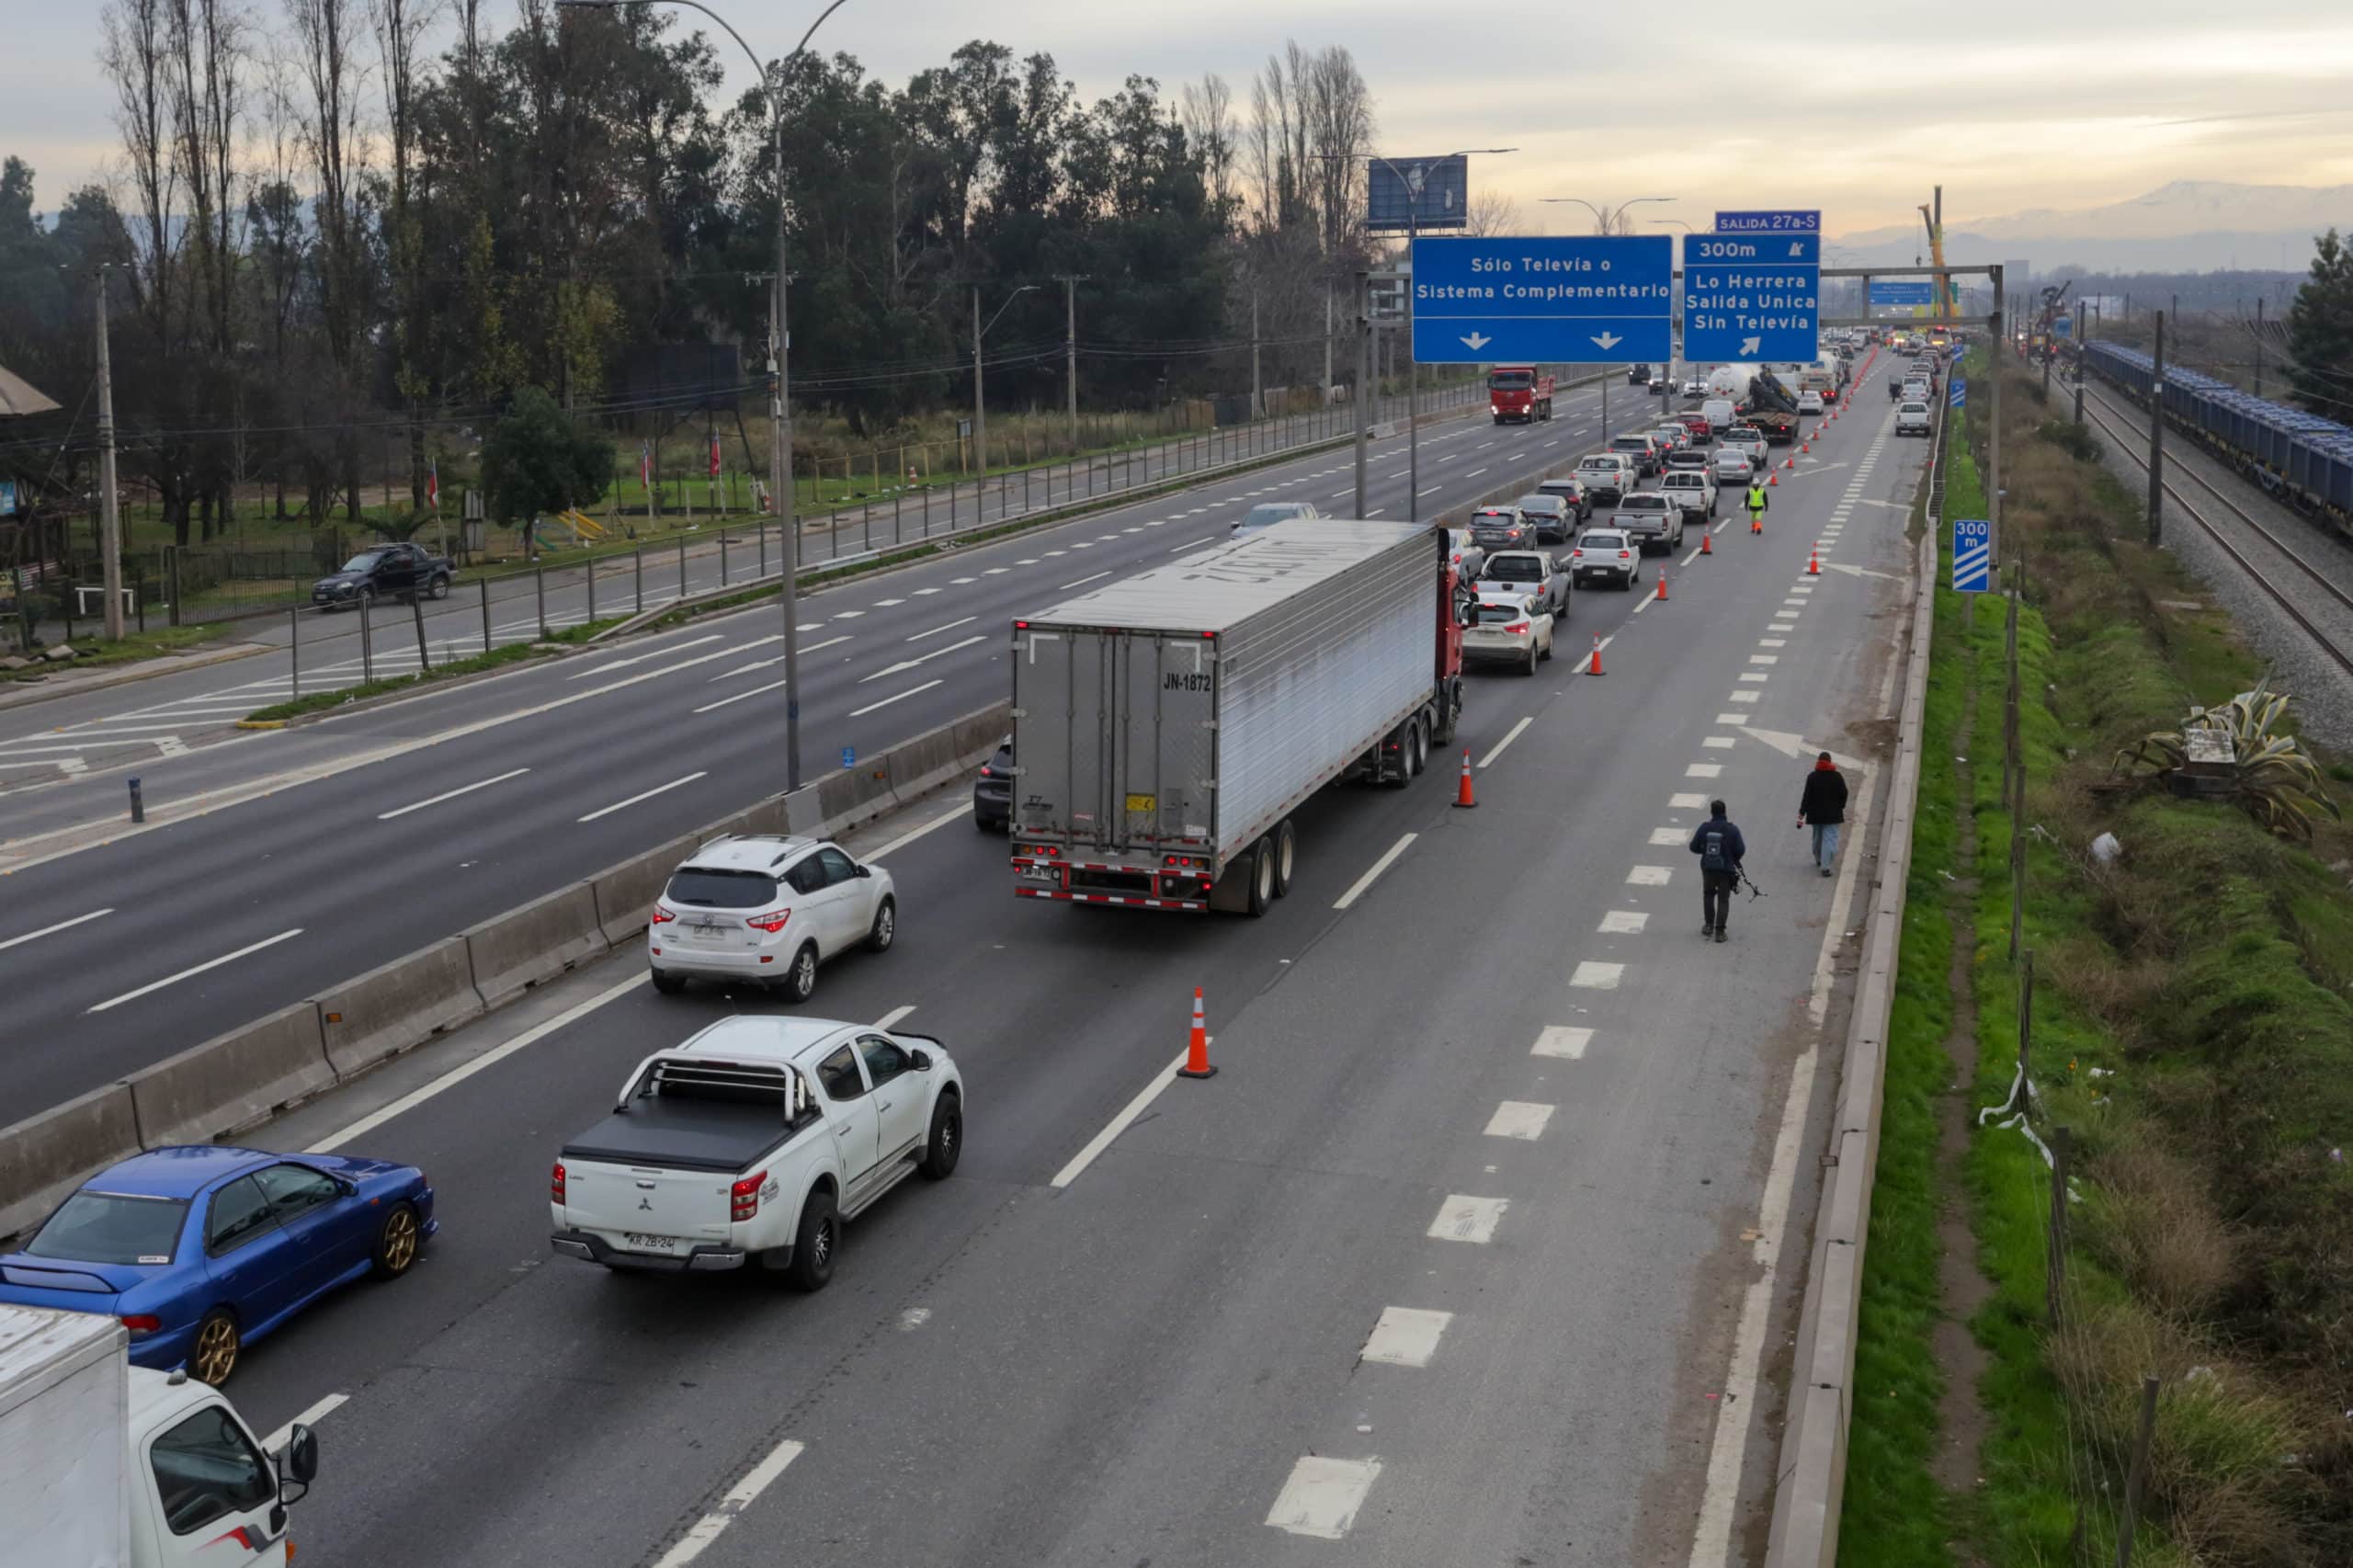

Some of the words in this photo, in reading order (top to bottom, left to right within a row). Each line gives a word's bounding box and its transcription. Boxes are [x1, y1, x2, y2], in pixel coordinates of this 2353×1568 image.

[1720, 219, 1768, 229] SALIDA
[1772, 215, 1815, 228] 27a-S
[1699, 243, 1756, 256] 300m
[1471, 257, 1512, 272] Sólo
[1522, 257, 1592, 272] Televía
[1600, 260, 1611, 271] o
[1696, 275, 1719, 289] Lo
[1728, 275, 1805, 289] Herrera
[1417, 285, 1494, 299] Sistema
[1503, 284, 1669, 301] Complementario
[1687, 295, 1749, 309] Salida
[1757, 294, 1815, 309] Unica
[1694, 315, 1726, 329] Sin
[1735, 314, 1808, 329] Televía
[1957, 523, 1986, 535] 300
[1965, 538, 1977, 547] m
